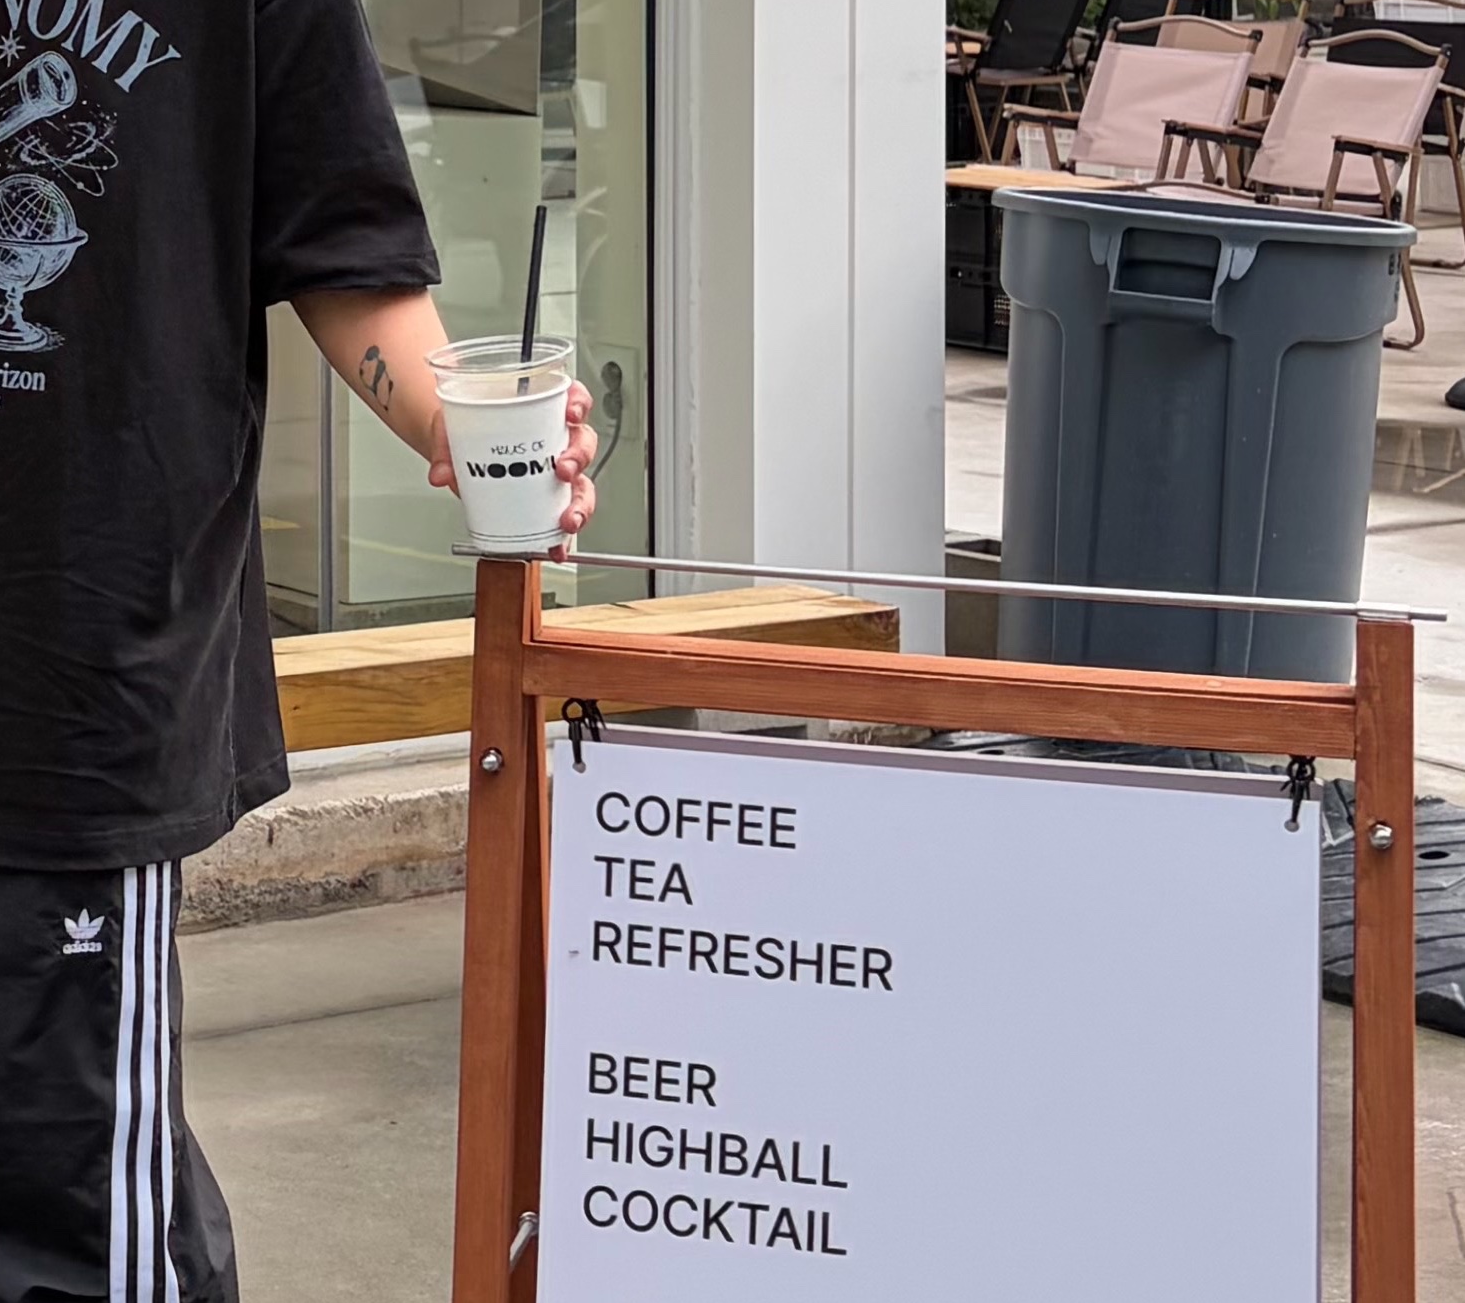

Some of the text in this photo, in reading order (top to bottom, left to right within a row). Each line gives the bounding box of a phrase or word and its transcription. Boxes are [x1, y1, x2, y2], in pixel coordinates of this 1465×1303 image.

[466, 455, 558, 478] WOOM
[531, 439, 546, 453] OF
[595, 791, 798, 850] COFFEE
[593, 854, 694, 906] TEA
[62, 939, 103, 954] adidas
[592, 919, 894, 992] REFRESHER
[587, 1051, 718, 1108] BEER
[585, 1117, 849, 1189] HIGHBALL
[582, 1184, 848, 1256] COCKTAIL
